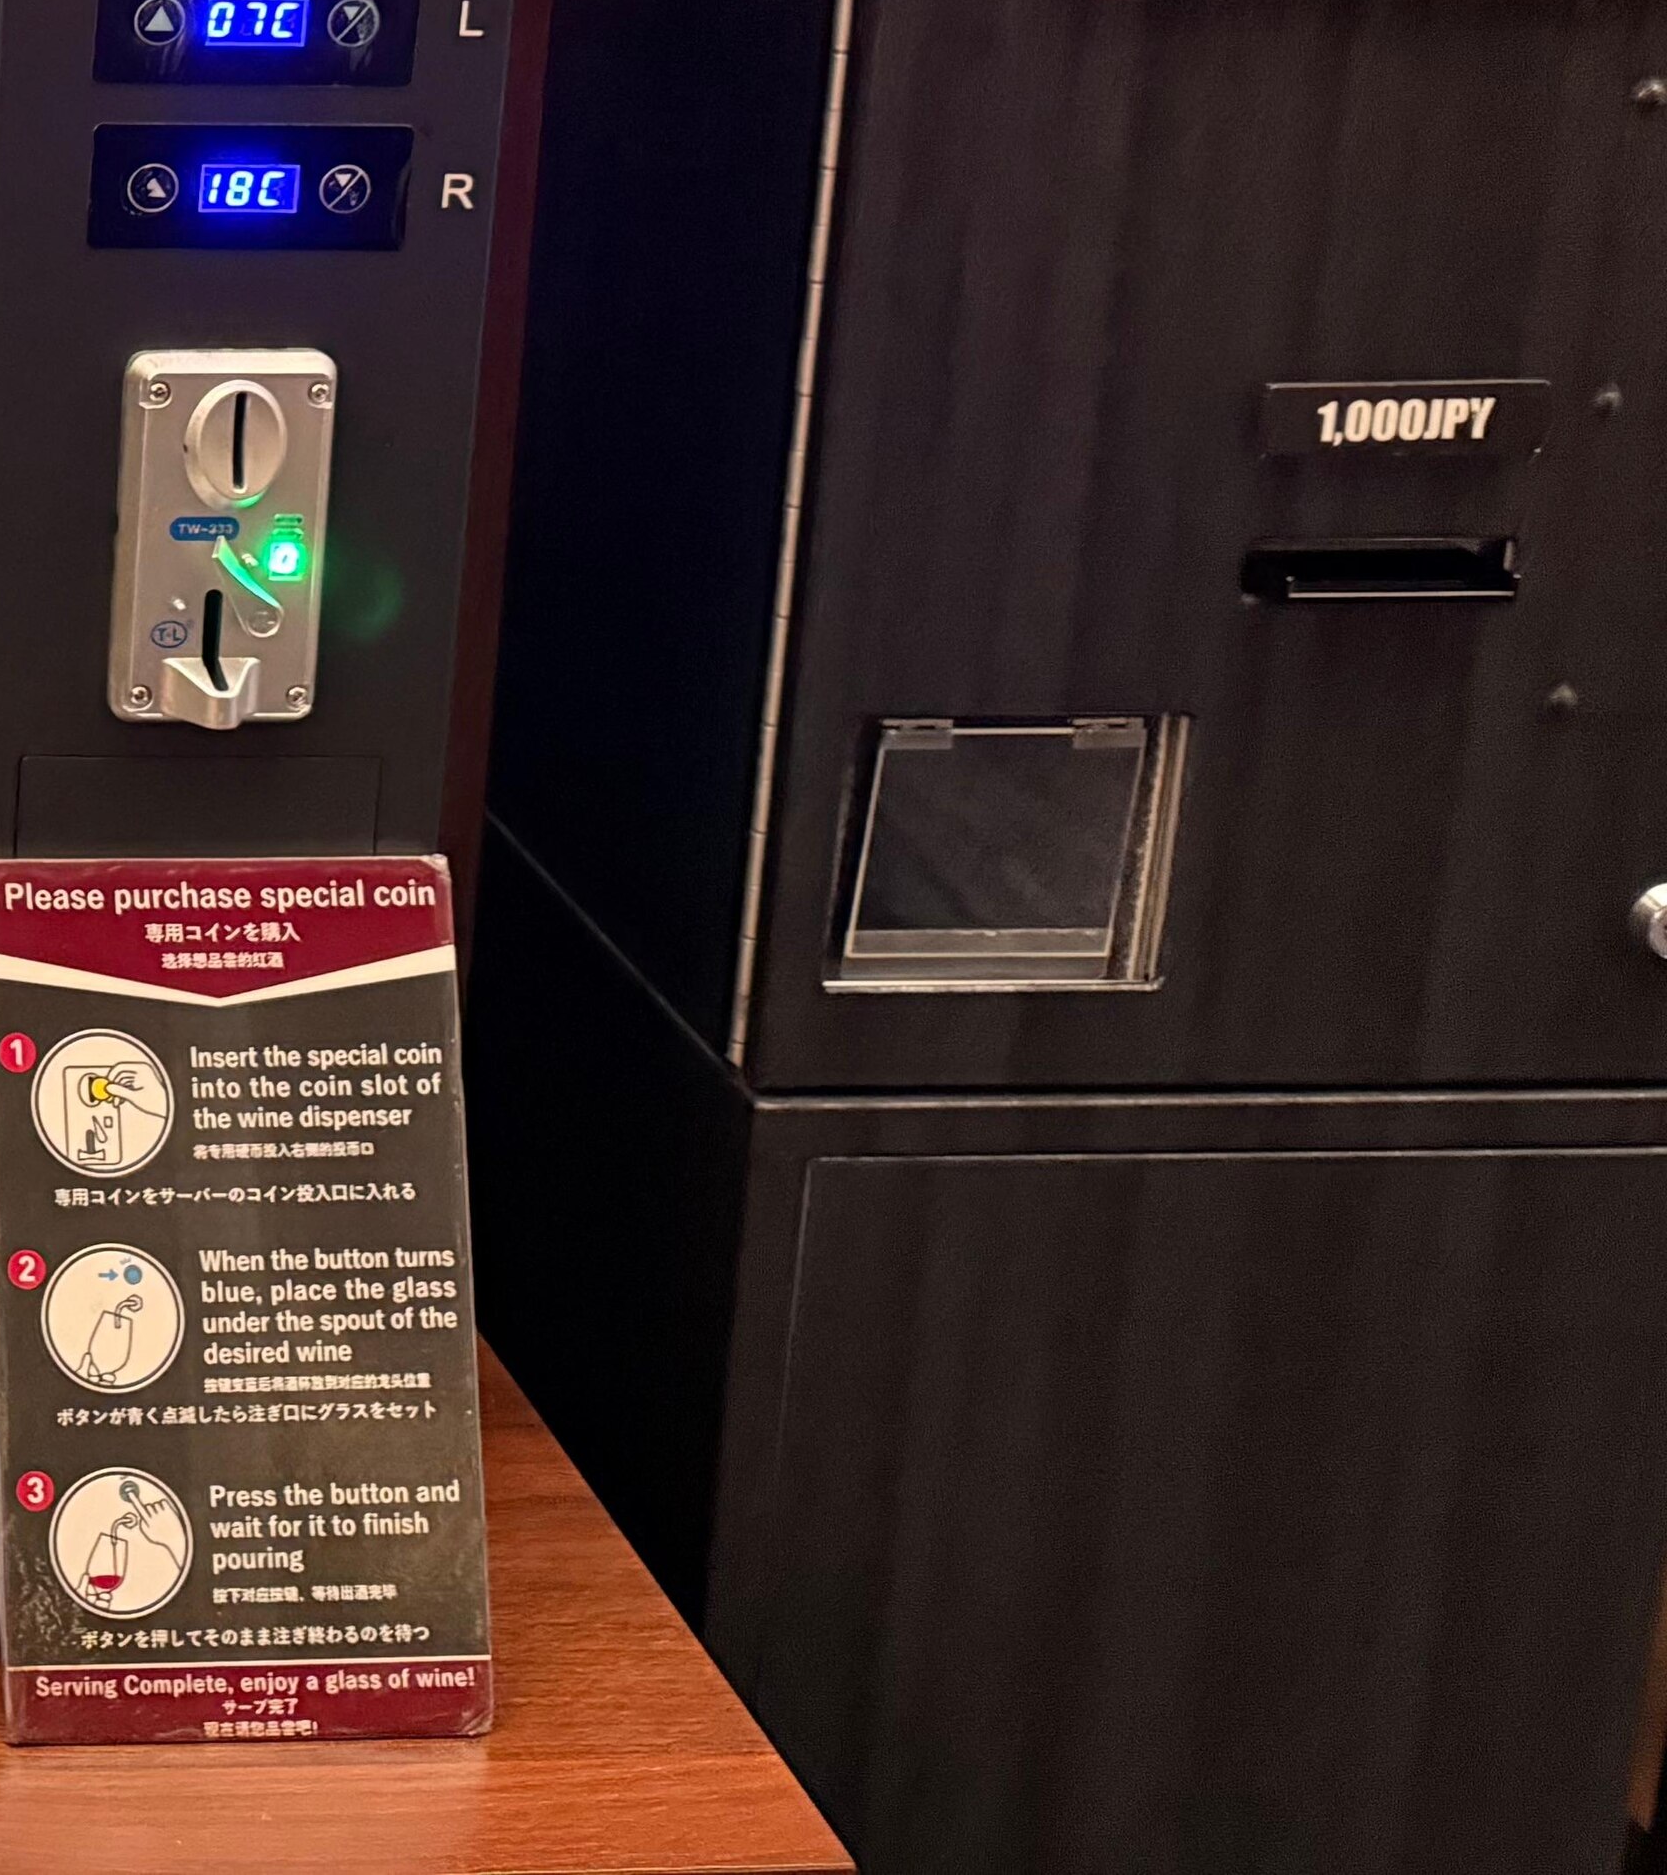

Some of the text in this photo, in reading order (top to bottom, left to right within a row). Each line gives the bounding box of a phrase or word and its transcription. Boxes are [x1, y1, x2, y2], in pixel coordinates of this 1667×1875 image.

[460, 1, 484, 37] L
[441, 173, 474, 209] R
[1317, 397, 1496, 447] 1,000JPY
[5, 879, 435, 914] Please purchase special coin
[144, 923, 301, 943] 専用コインを購入
[9, 1039, 25, 1066] 1
[190, 1043, 442, 1072] Insert the special coin
[191, 1073, 442, 1099] into the coin slot of
[193, 1105, 412, 1134] the wine dispenser
[54, 1183, 416, 1207] 専用コインをサーバーのコイン投入口に入れる
[18, 1255, 36, 1283] 2
[199, 1247, 455, 1273] When the button turns
[201, 1278, 457, 1305] blue, place the glass
[202, 1308, 458, 1337] under the spout of the
[203, 1342, 352, 1365] desired wine
[26, 1476, 45, 1504] 3
[210, 1480, 460, 1508] Press the button and
[210, 1513, 429, 1539] wait for it to finish
[212, 1547, 305, 1575] pouring
[80, 1625, 431, 1649] ボタンを押してそのまま注ぎ終わるのを待つ
[36, 1668, 476, 1698] Serving Complete, enjoy a glass of wine!
